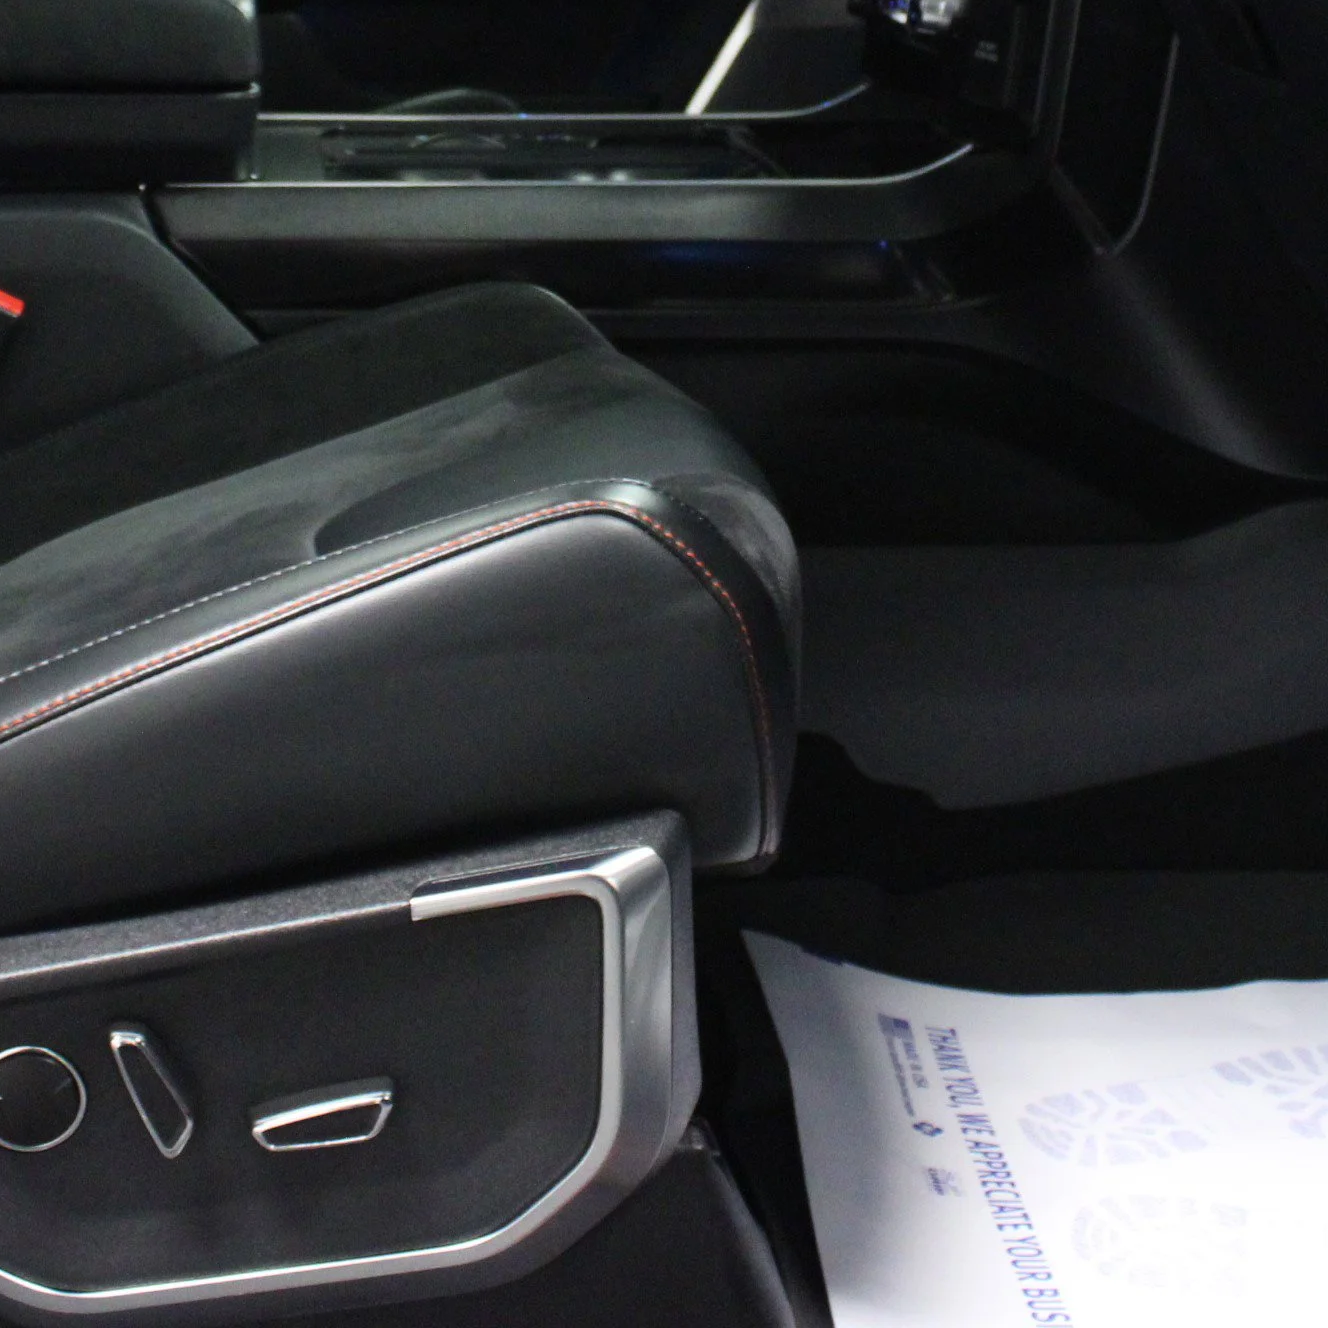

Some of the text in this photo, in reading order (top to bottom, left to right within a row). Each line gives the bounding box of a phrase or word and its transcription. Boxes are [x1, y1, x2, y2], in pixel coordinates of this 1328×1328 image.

[925, 1026, 971, 1073] THANK
[943, 1076, 984, 1108] YOU,
[955, 1113, 996, 1137] WE
[964, 1139, 1034, 1232] APPRECIATE
[1002, 1235, 1053, 1282] YOUR
